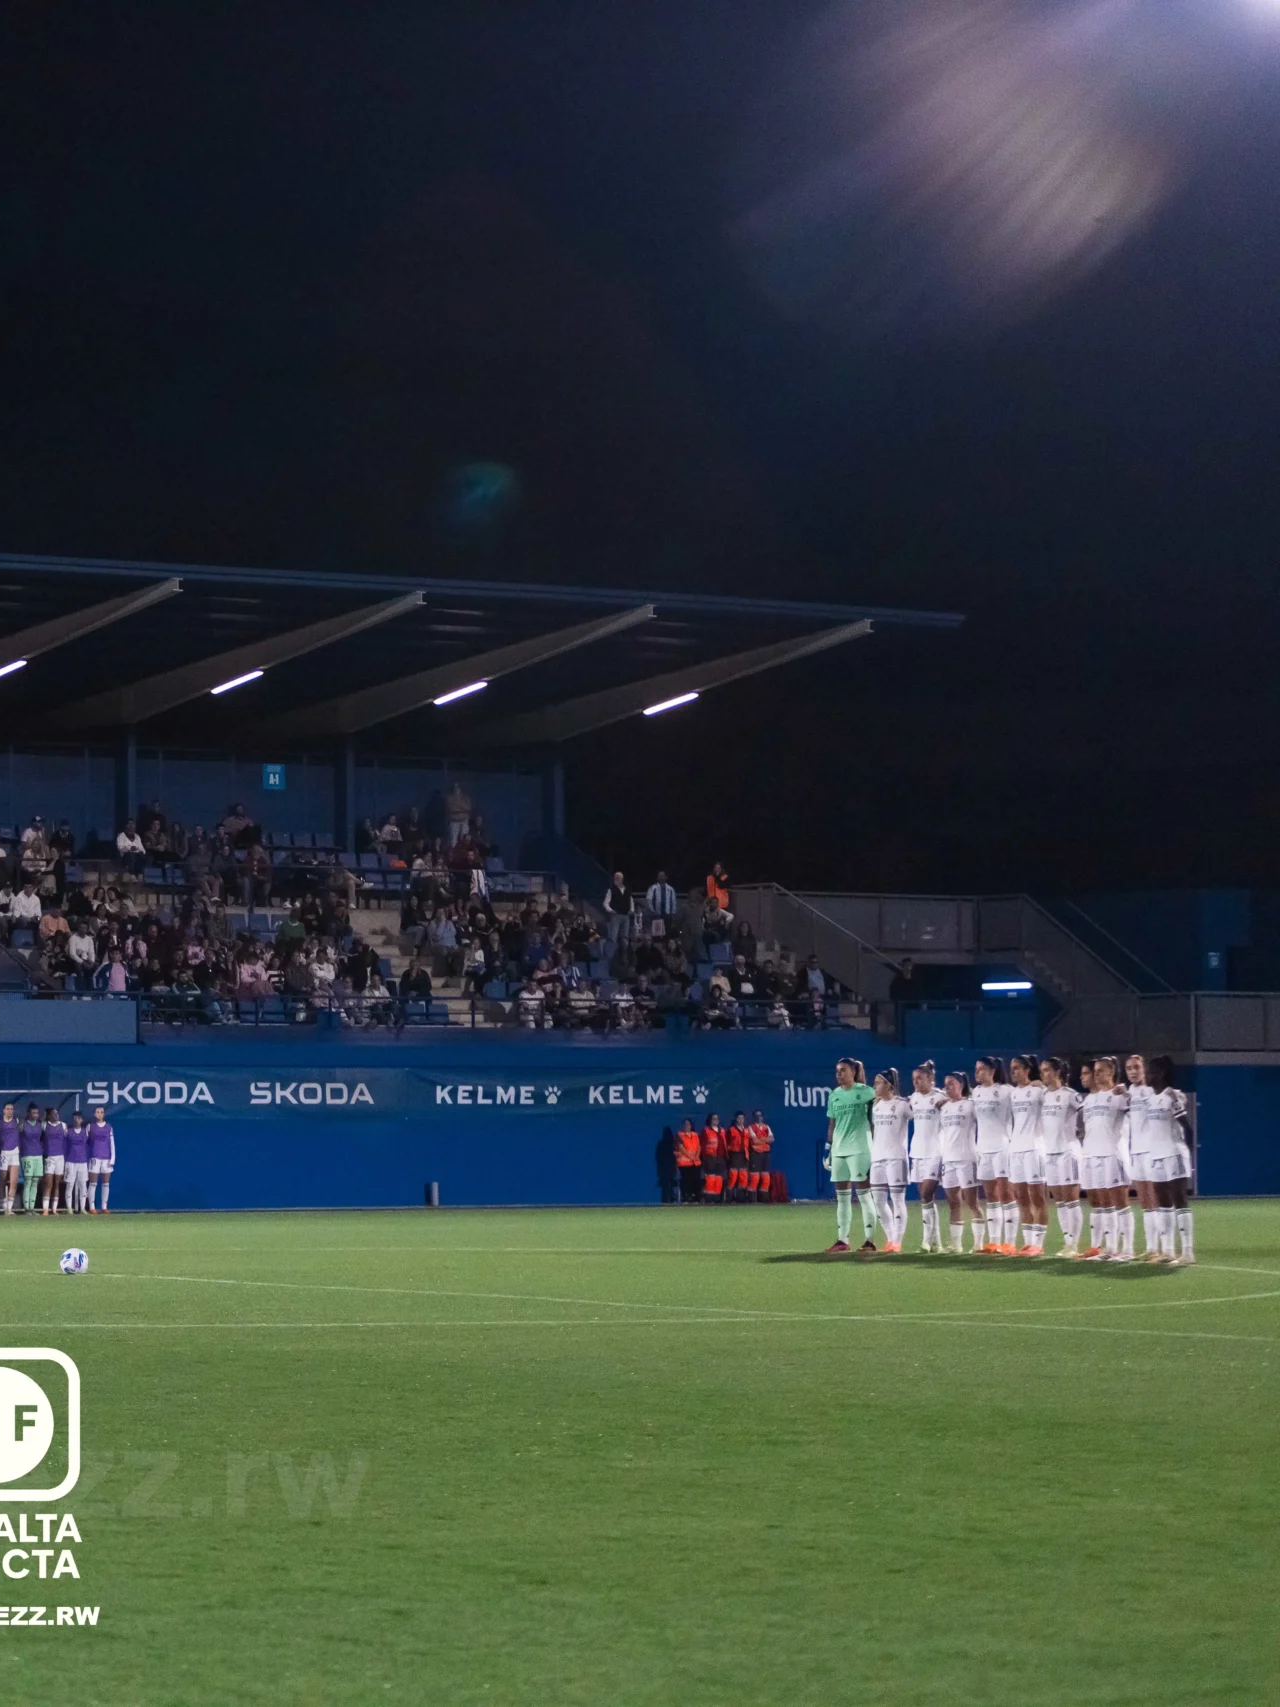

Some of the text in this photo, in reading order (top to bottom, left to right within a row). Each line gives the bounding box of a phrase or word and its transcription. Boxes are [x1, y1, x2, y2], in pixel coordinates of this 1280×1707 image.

[269, 773, 280, 785] A-1
[436, 1085, 535, 1105] KELME
[589, 1084, 684, 1105] KELME
